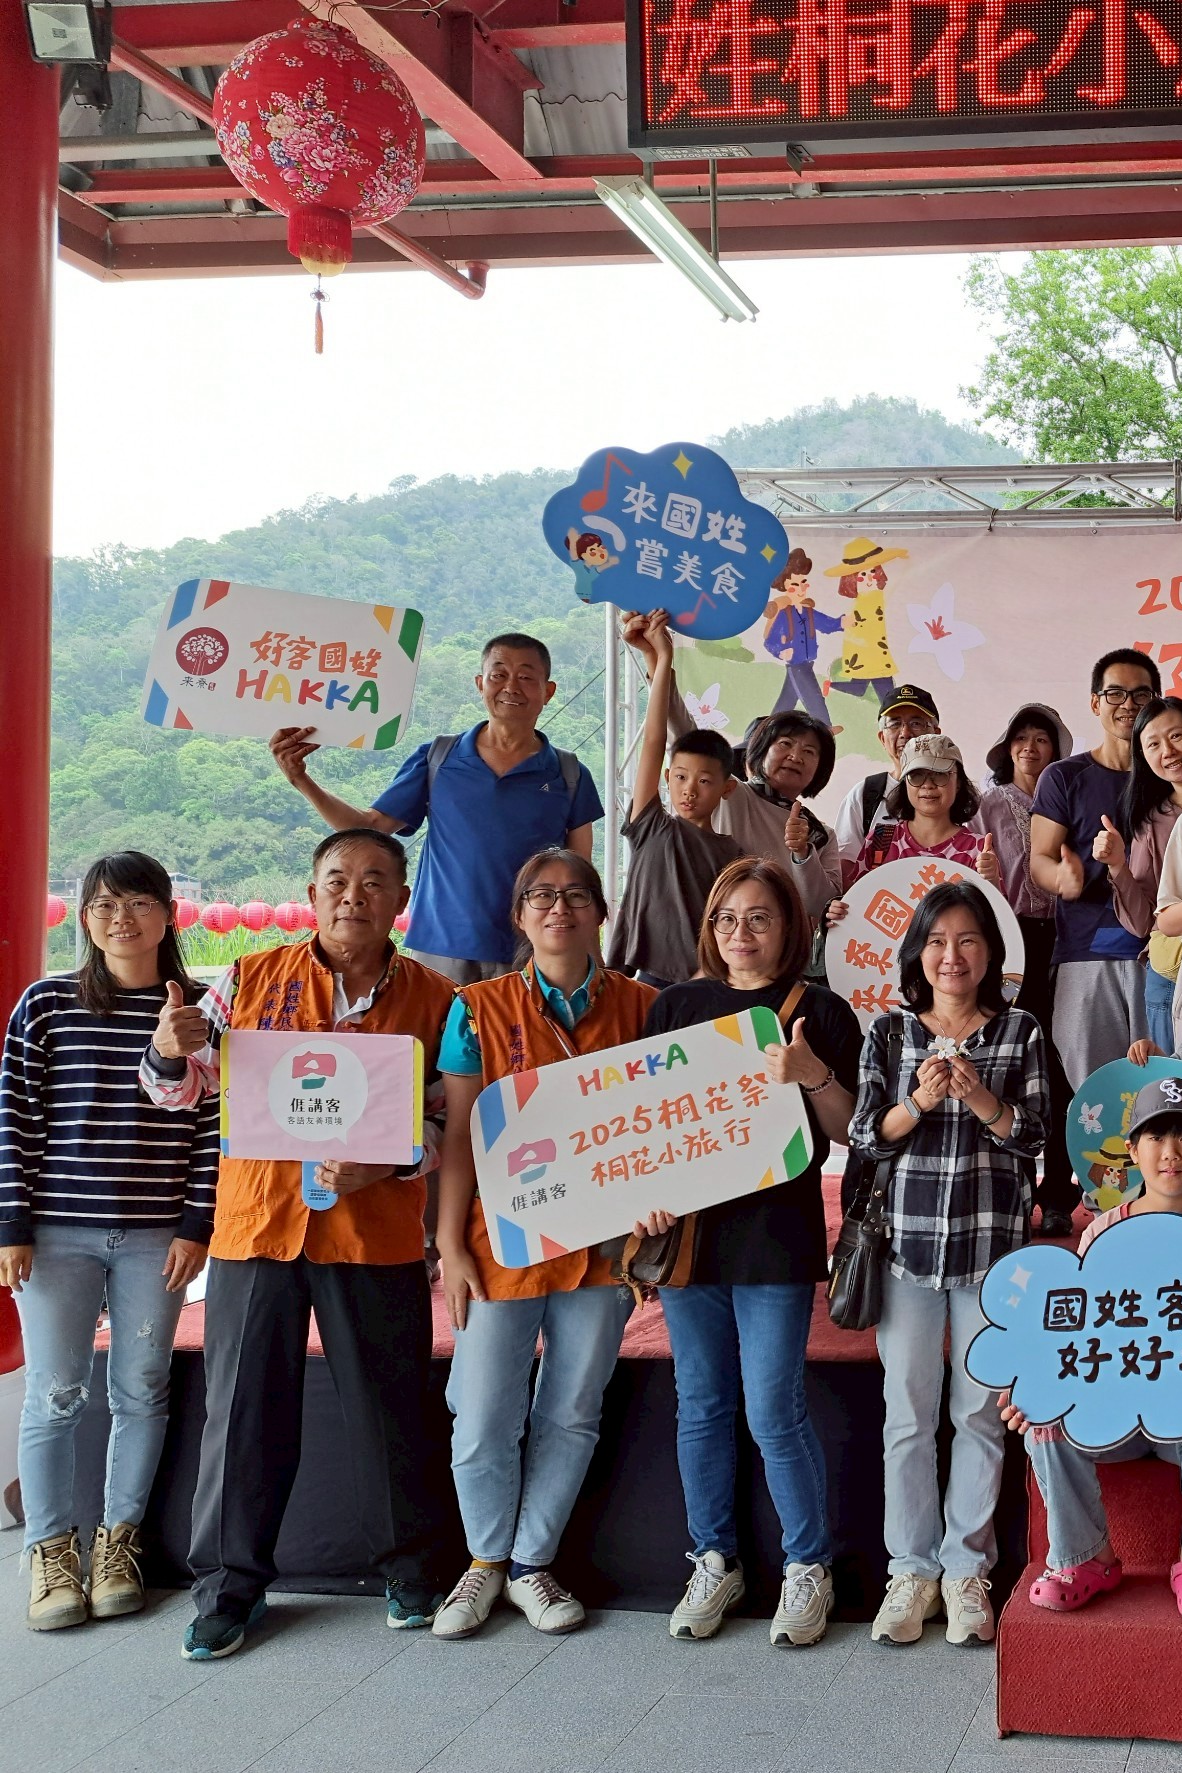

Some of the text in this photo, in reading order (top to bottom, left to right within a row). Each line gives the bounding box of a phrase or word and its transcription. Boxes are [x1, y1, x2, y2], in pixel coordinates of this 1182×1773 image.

[621, 481, 747, 554] 來國姓
[635, 538, 746, 603] 嘗美食
[249, 630, 382, 679] 好客國姓
[235, 668, 380, 714] HAKKA
[576, 1043, 689, 1096] HAKKA
[287, 1115, 344, 1127] 客語友善環境
[568, 1072, 769, 1157] 2025桐花祭
[591, 1118, 752, 1188] 桐花小旅行
